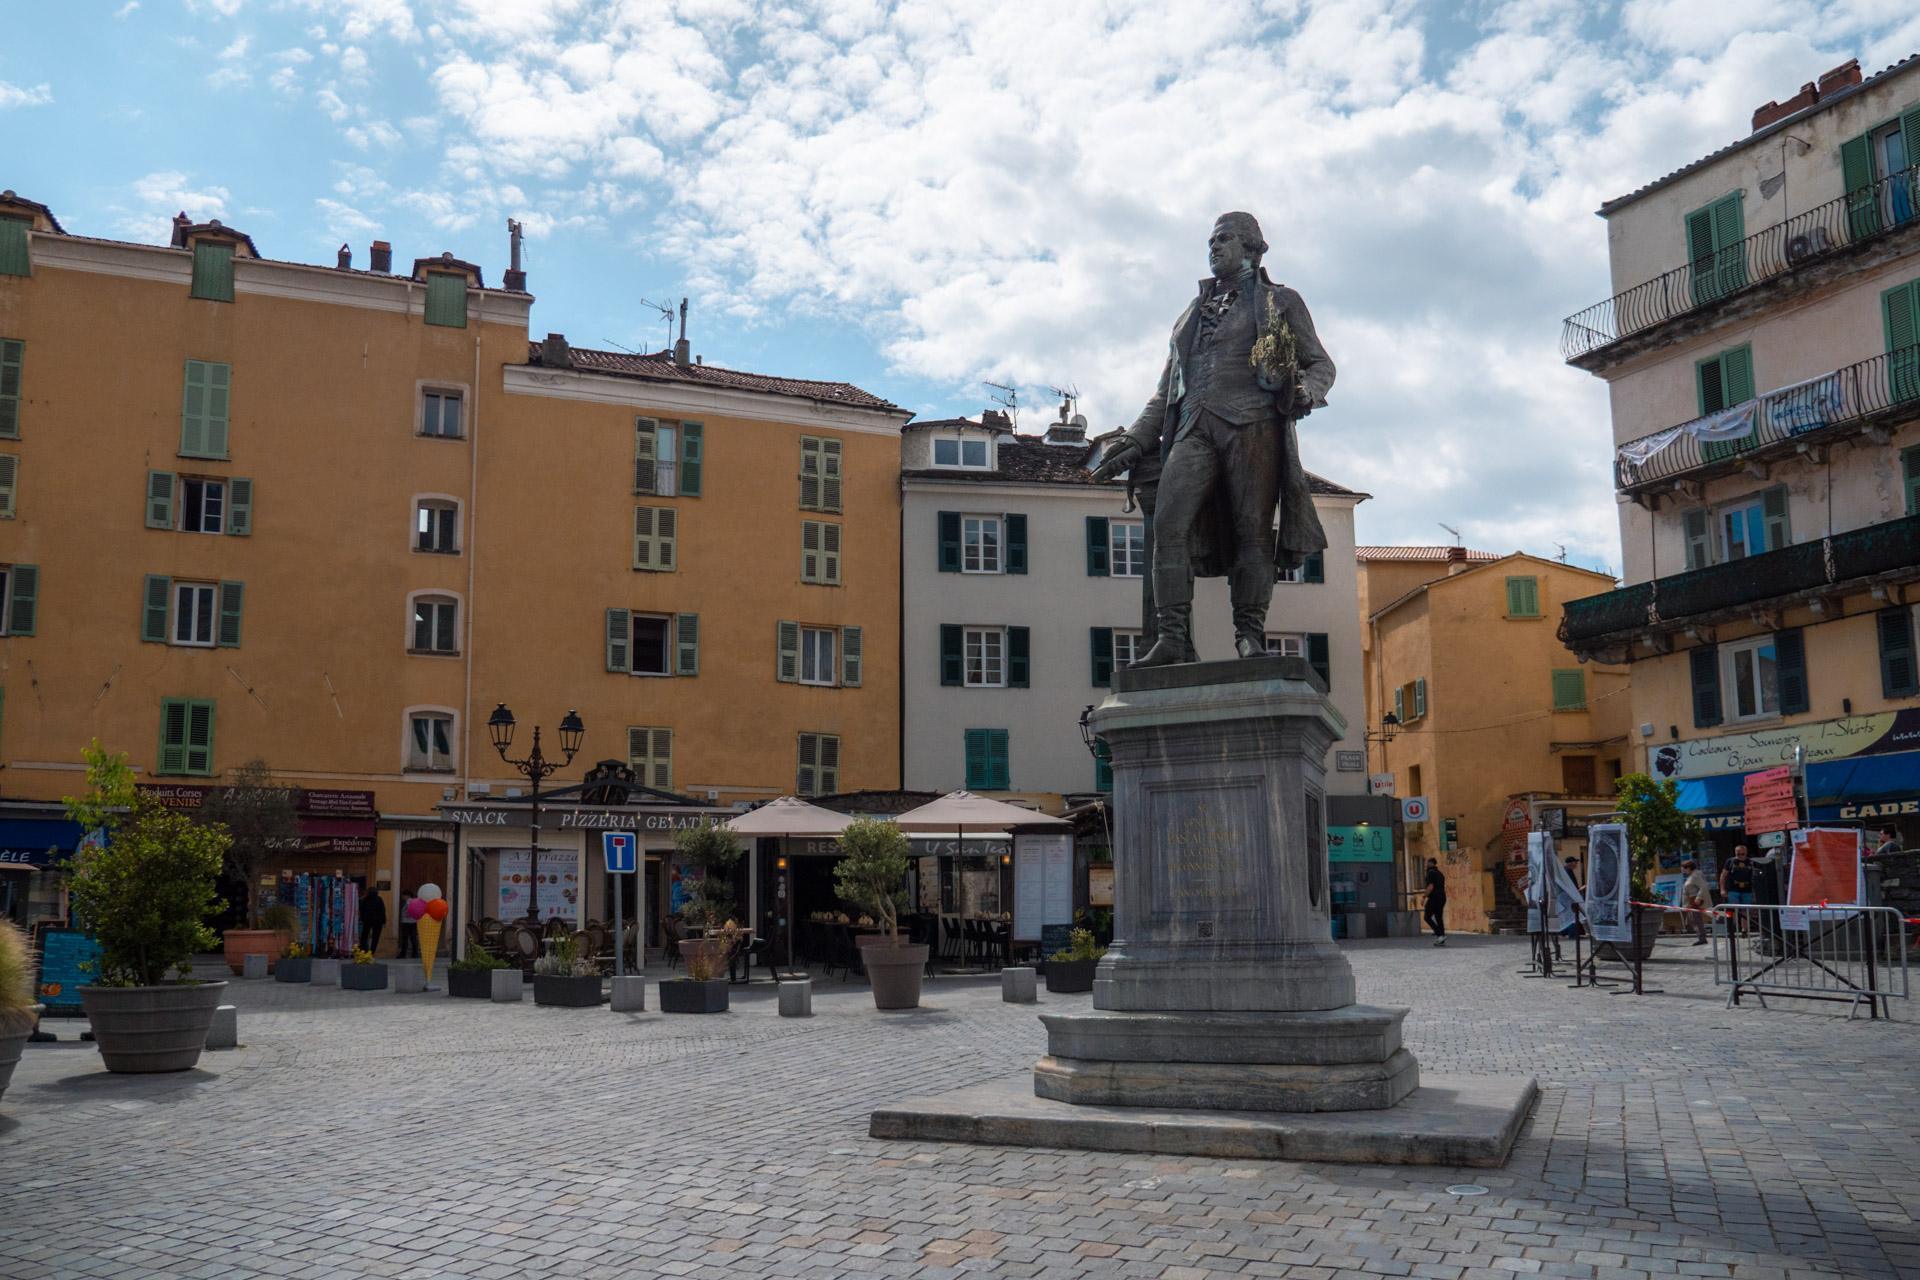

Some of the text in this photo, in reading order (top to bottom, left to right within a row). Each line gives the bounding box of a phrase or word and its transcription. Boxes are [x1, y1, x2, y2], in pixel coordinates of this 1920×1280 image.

[1727, 743, 1834, 769] Bijoux Coteaux
[452, 810, 508, 825] SNACK
[561, 814, 637, 828] PIZZERIA
